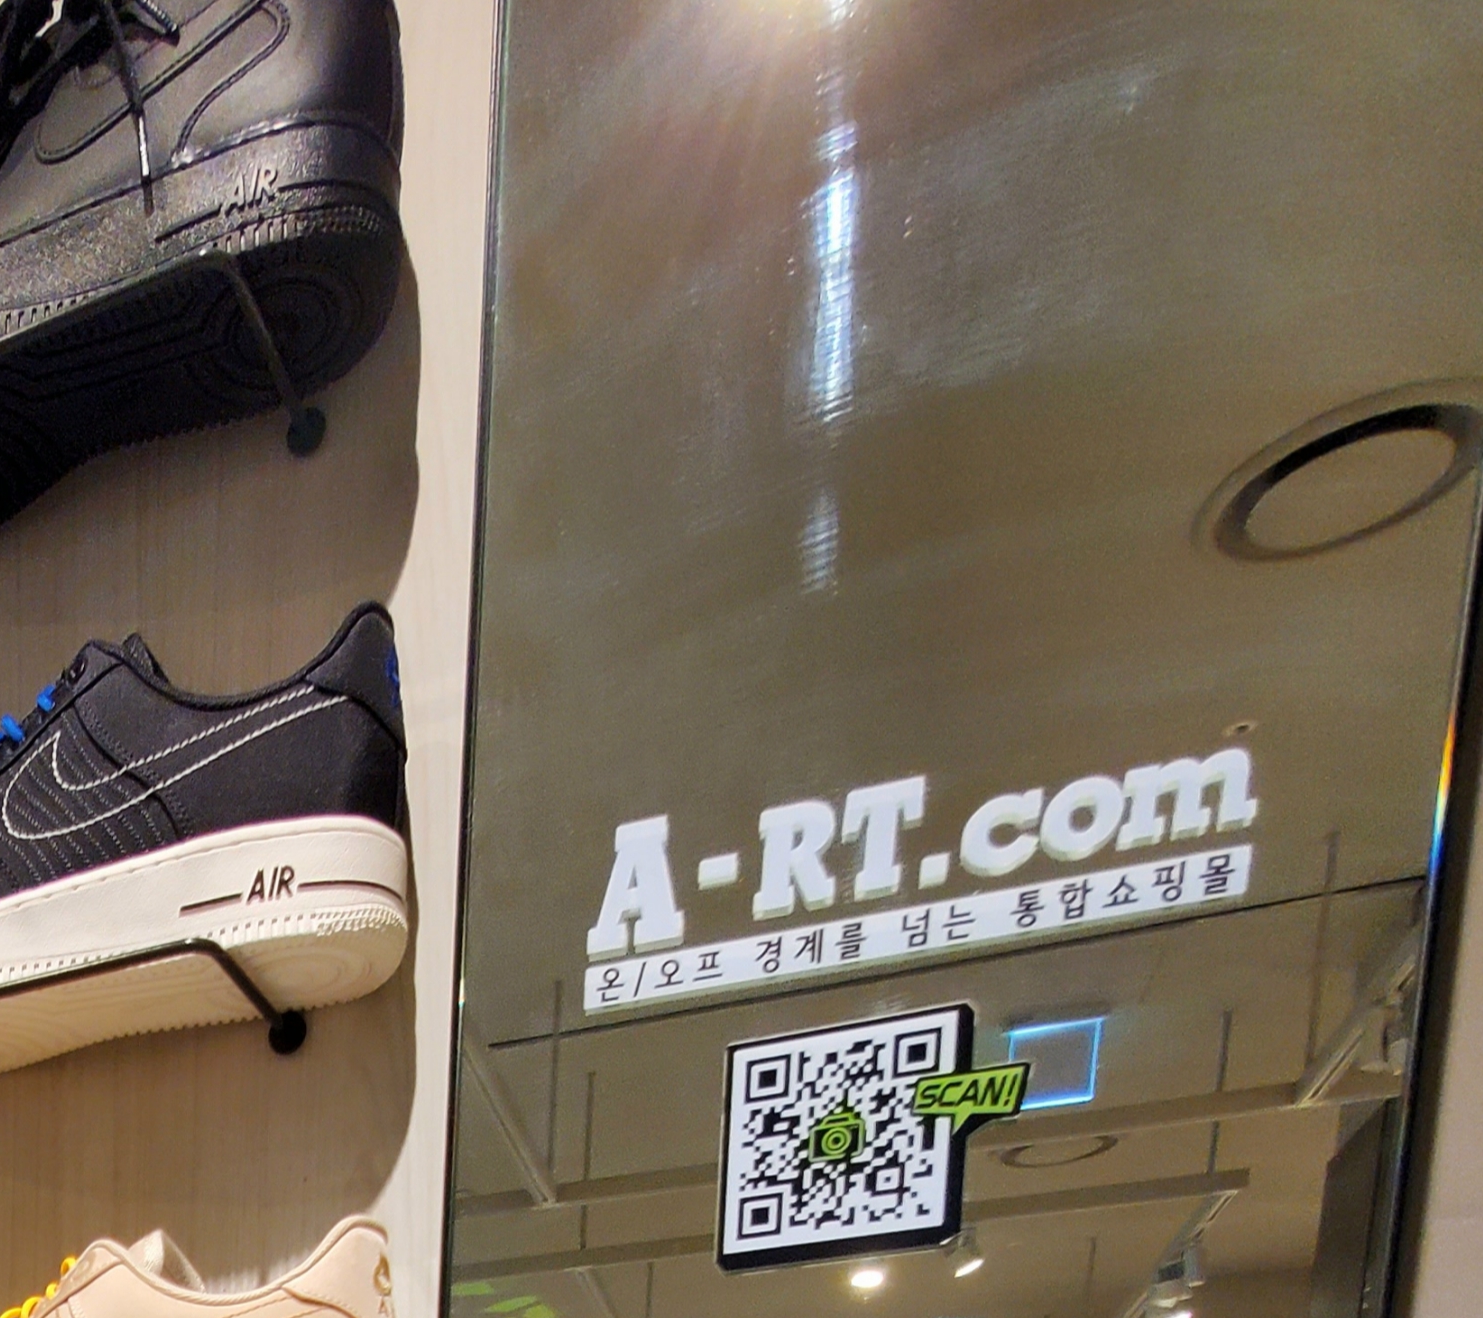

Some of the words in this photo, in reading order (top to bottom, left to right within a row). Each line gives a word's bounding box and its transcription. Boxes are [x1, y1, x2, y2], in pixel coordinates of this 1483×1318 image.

[221, 164, 278, 215] AIR
[587, 746, 1258, 961] A-RT.com
[245, 865, 296, 905] AIR
[595, 947, 724, 1005] 온/오프
[755, 921, 868, 976] 경계를
[901, 905, 977, 949] 넘는
[1010, 852, 1236, 928] 통합쇼핑몰
[915, 1073, 1019, 1109] SCAN!
